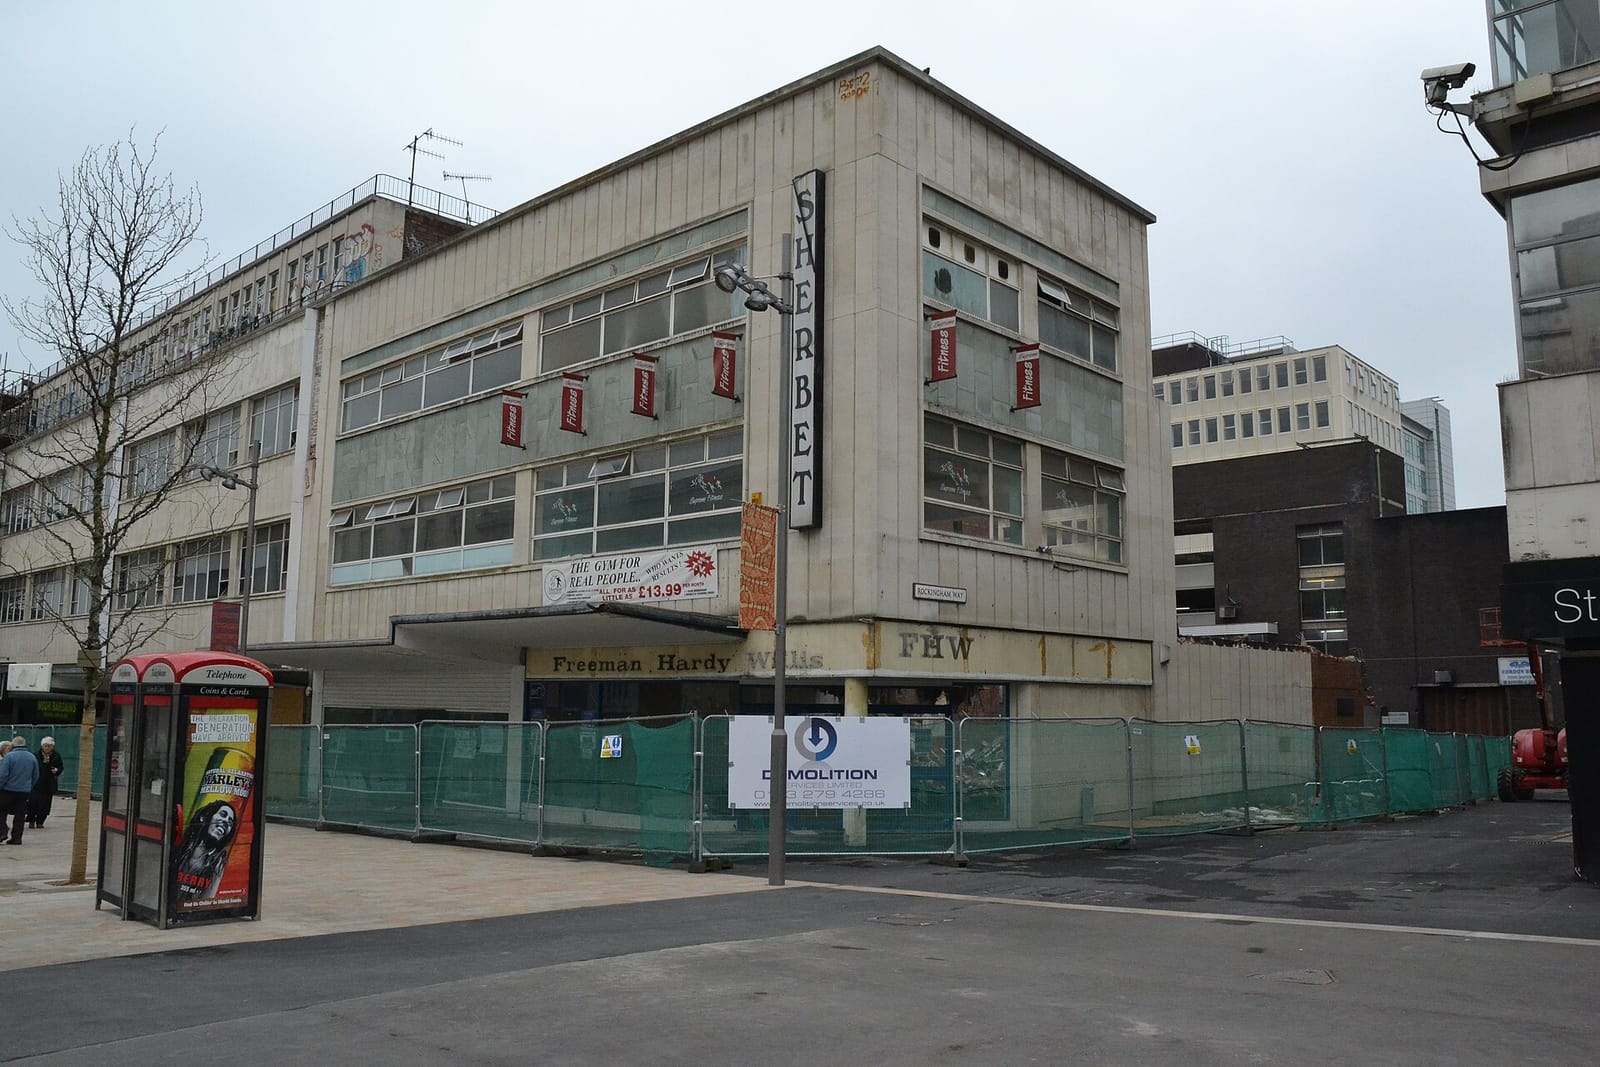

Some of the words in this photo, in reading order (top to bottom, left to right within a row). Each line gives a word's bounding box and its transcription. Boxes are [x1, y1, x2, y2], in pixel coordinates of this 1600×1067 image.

[792, 188, 815, 506] SHERBET
[937, 329, 949, 373] Fitness
[718, 348, 730, 392] Fitness
[1022, 361, 1034, 401] Fitness
[639, 370, 649, 411] Fitness
[566, 388, 578, 427] Fitness
[506, 405, 517, 441] Fitness
[570, 561, 591, 574] THE
[595, 557, 617, 572] GYM
[619, 556, 641, 569] FOR
[661, 551, 684, 568] WANTS
[569, 574, 594, 588] REAL
[602, 594, 623, 602] LITTLE
[639, 583, 682, 599] £13.99
[916, 587, 952, 599] ROCKINGHAM
[952, 591, 965, 600] WAY
[898, 632, 976, 660] FHW
[657, 653, 731, 673] Hardy
[748, 650, 825, 669] Wilis
[206, 669, 248, 681] Telephone
[200, 686, 220, 696] Coins
[221, 687, 228, 696] &
[229, 687, 250, 697] Cards
[197, 723, 254, 732] GENERATION
[192, 733, 212, 741] HAVE
[217, 733, 249, 741] ARRIVED
[762, 769, 878, 780] DMOLITION
[200, 785, 233, 794] MELLOW
[802, 790, 836, 799] 279
[841, 790, 886, 799] 4286
[176, 871, 212, 889] BERRY
